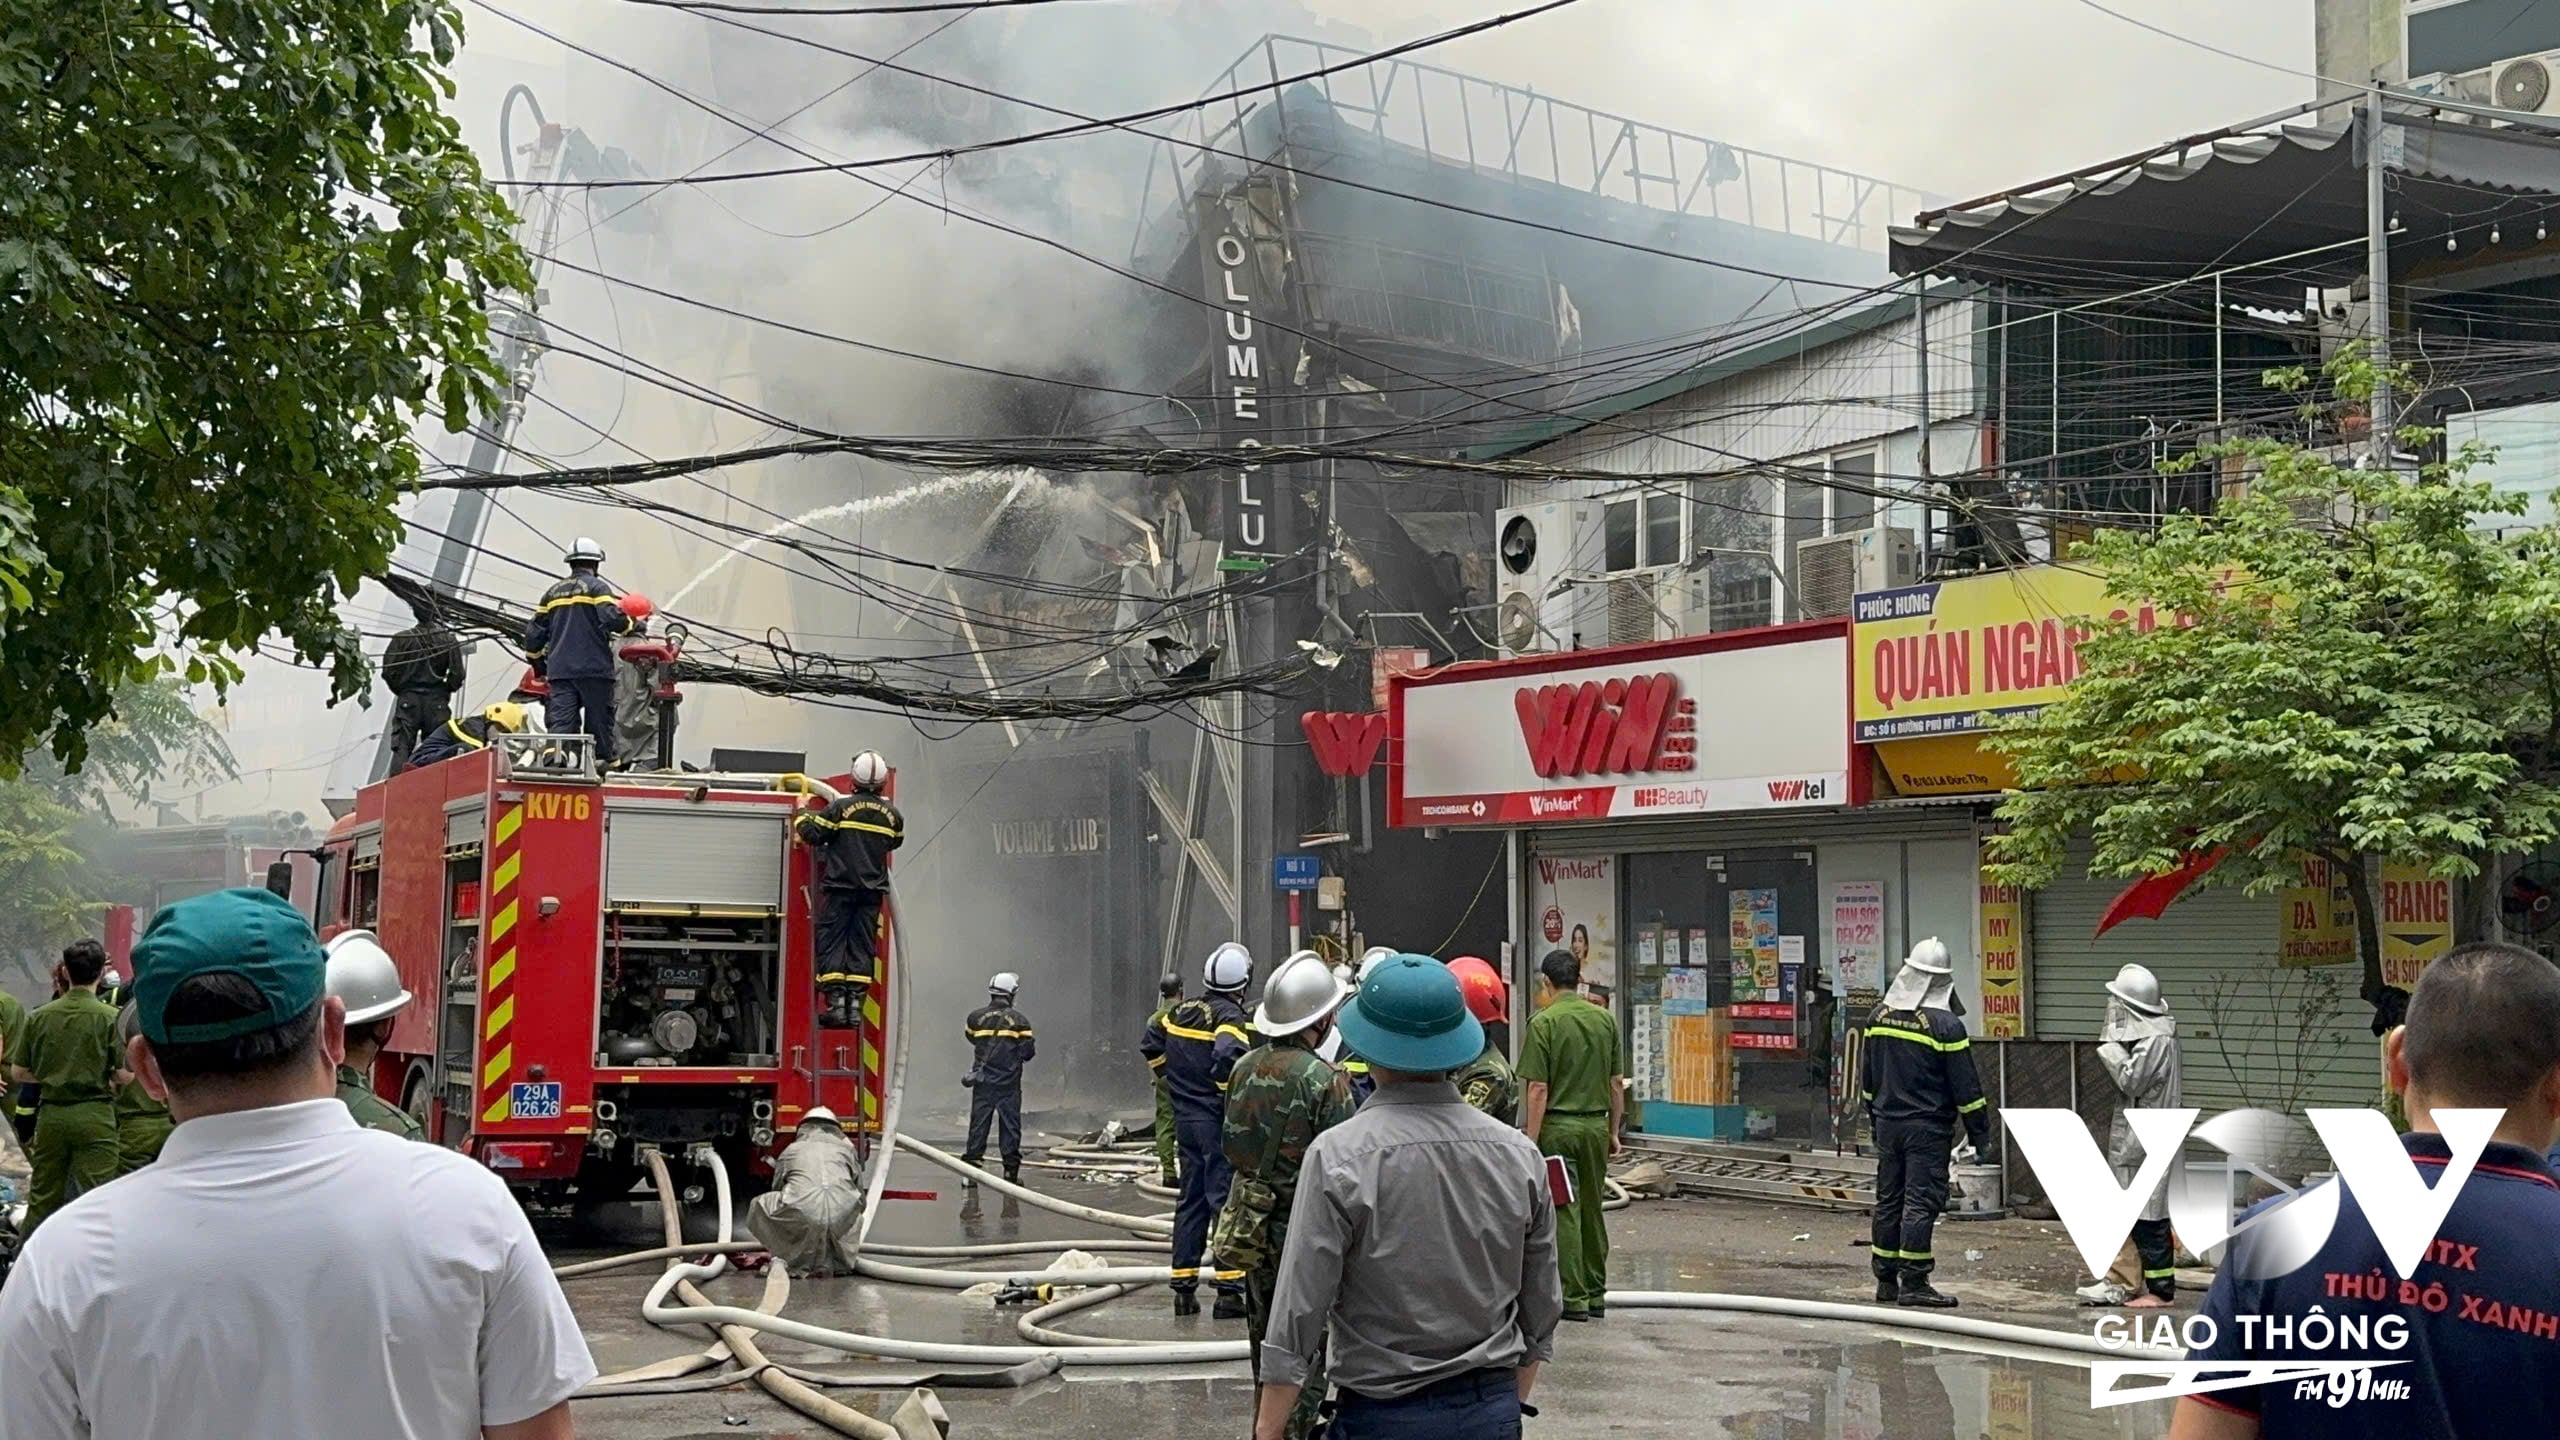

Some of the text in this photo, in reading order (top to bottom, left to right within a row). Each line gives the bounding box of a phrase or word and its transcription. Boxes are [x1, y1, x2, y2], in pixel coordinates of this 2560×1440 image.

[1874, 618, 1971, 711] QUÁN
[527, 792, 591, 820] KV16
[2301, 859, 2327, 889] NH
[1984, 995, 2019, 1014] NGAN
[523, 1084, 549, 1101] 29A
[2324, 1267, 2560, 1340] THỦ ĐÔ XANH
